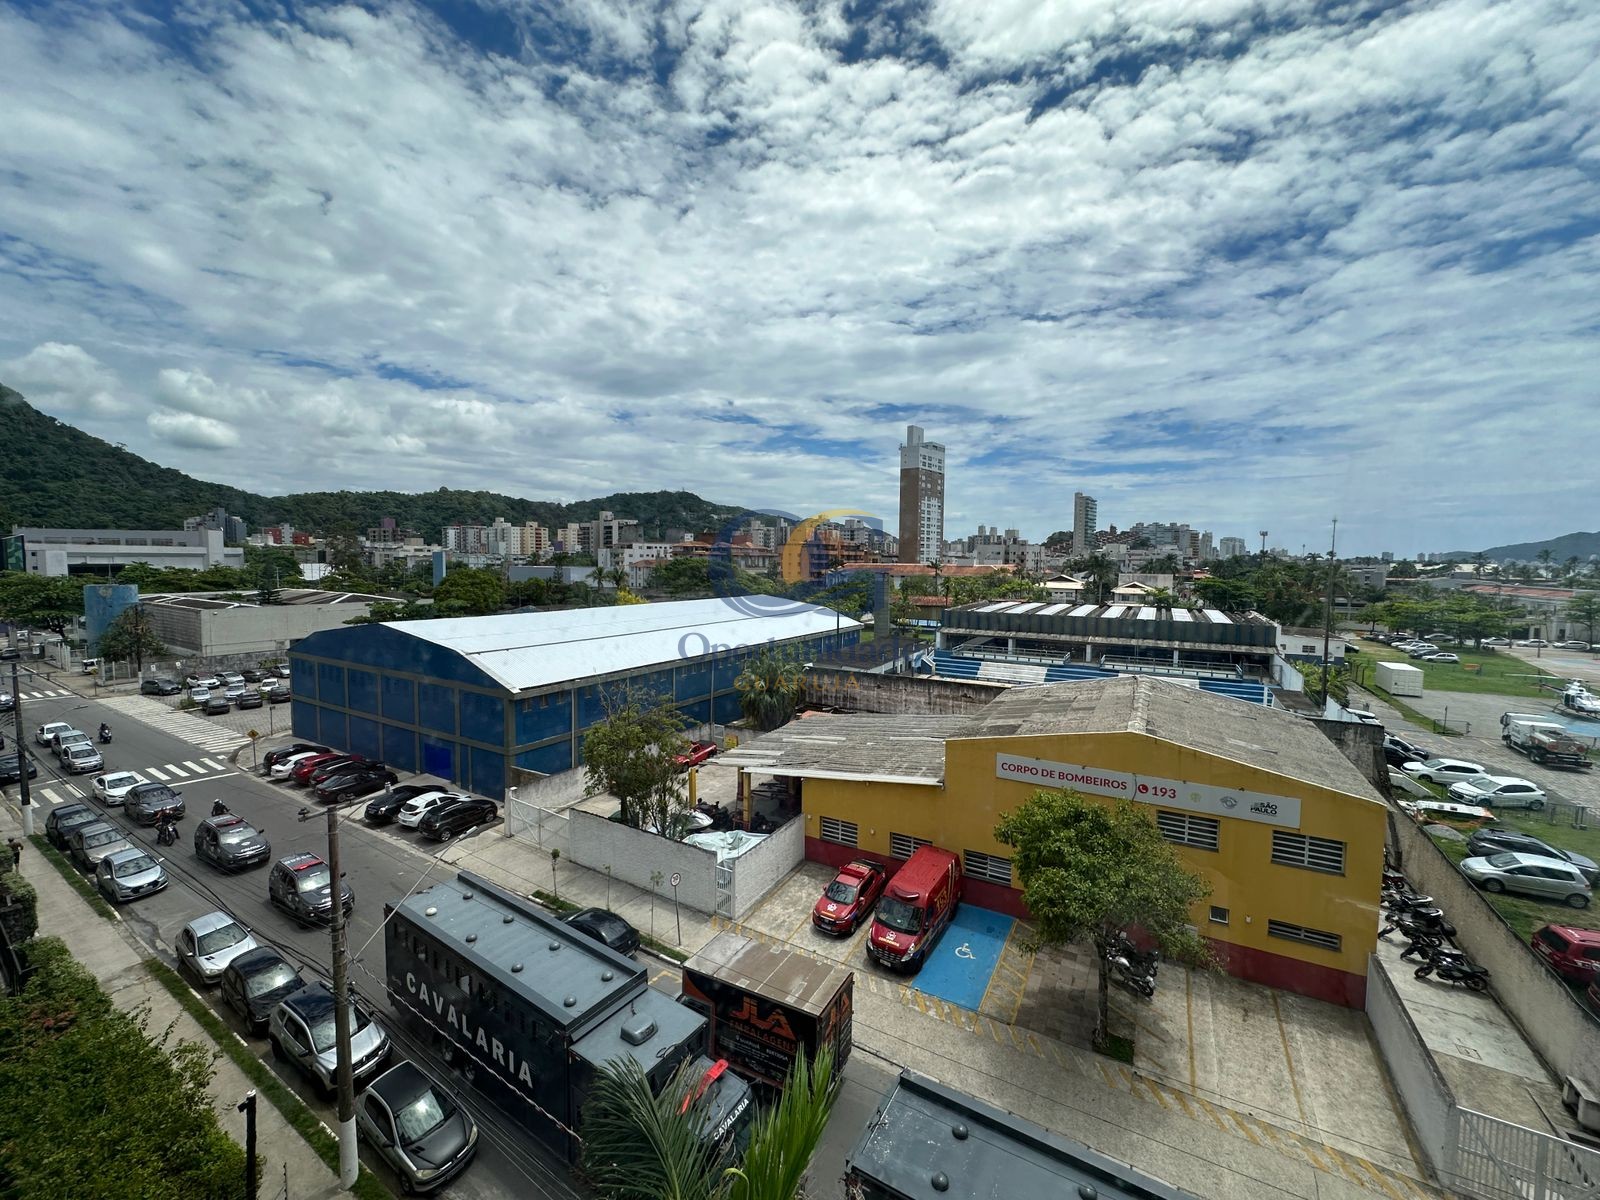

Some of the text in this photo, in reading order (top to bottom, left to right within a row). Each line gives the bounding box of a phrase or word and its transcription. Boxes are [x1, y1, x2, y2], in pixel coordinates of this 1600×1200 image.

[1001, 762, 1176, 800] CORPO DE BOMBEIROS 193
[1250, 807, 1278, 815] PAULO
[1260, 801, 1278, 810] SÃO
[406, 972, 534, 1089] CAVALARIA
[713, 1098, 750, 1141] CAVALARIA
